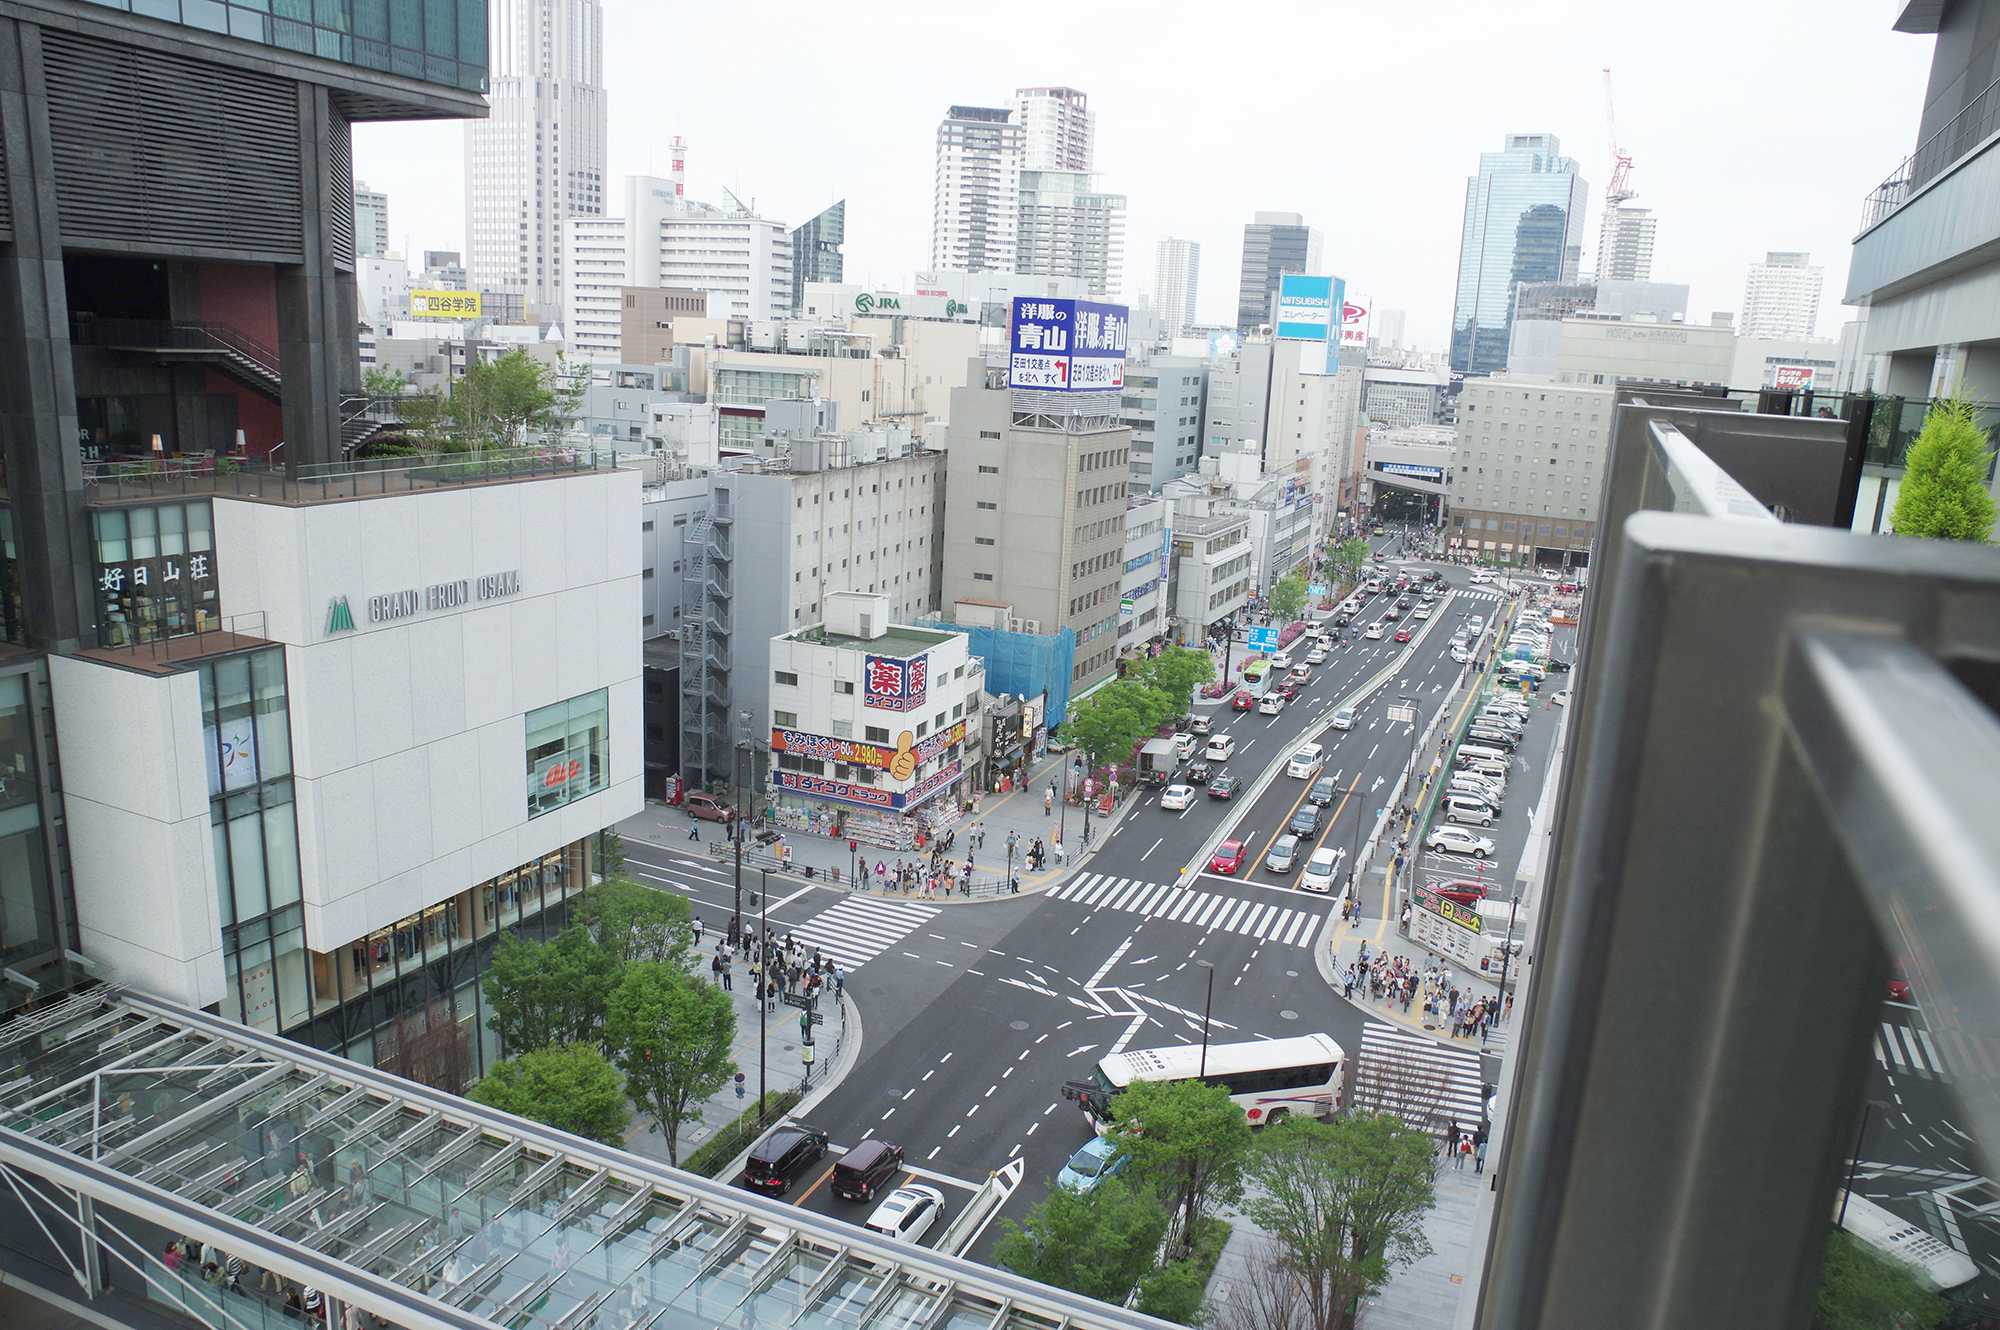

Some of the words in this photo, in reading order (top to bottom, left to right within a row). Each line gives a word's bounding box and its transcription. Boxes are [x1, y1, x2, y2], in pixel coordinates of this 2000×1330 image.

[428, 296, 477, 313] 四谷学院
[876, 298, 900, 309] JRA
[956, 303, 968, 314] JRA
[1281, 296, 1330, 307] MITSUBISHI
[1020, 303, 1067, 321] 洋服の
[1283, 310, 1325, 320] エレベーター
[1018, 323, 1067, 351] 青山
[1075, 311, 1127, 351] 洋服の青山
[1605, 327, 1632, 340] HOTEL
[1018, 372, 1039, 383] を北へ
[1044, 373, 1058, 384] すぐ
[1777, 376, 1810, 386] キタムラ
[1779, 369, 1802, 377] カメラの
[99, 554, 209, 591] 好日山荘
[370, 588, 420, 622] GRAND
[427, 578, 471, 611] FRONT
[478, 570, 522, 600] OSAKA
[867, 659, 902, 696] 薬
[909, 660, 926, 695] 薬
[866, 695, 903, 709] ダイコク
[783, 731, 840, 751] もみほぐし
[546, 759, 582, 787] au
[801, 777, 850, 797] ダイコク
[852, 789, 889, 804] ドラッグ
[1443, 901, 1452, 915] P
[1454, 907, 1472, 923] 入口
